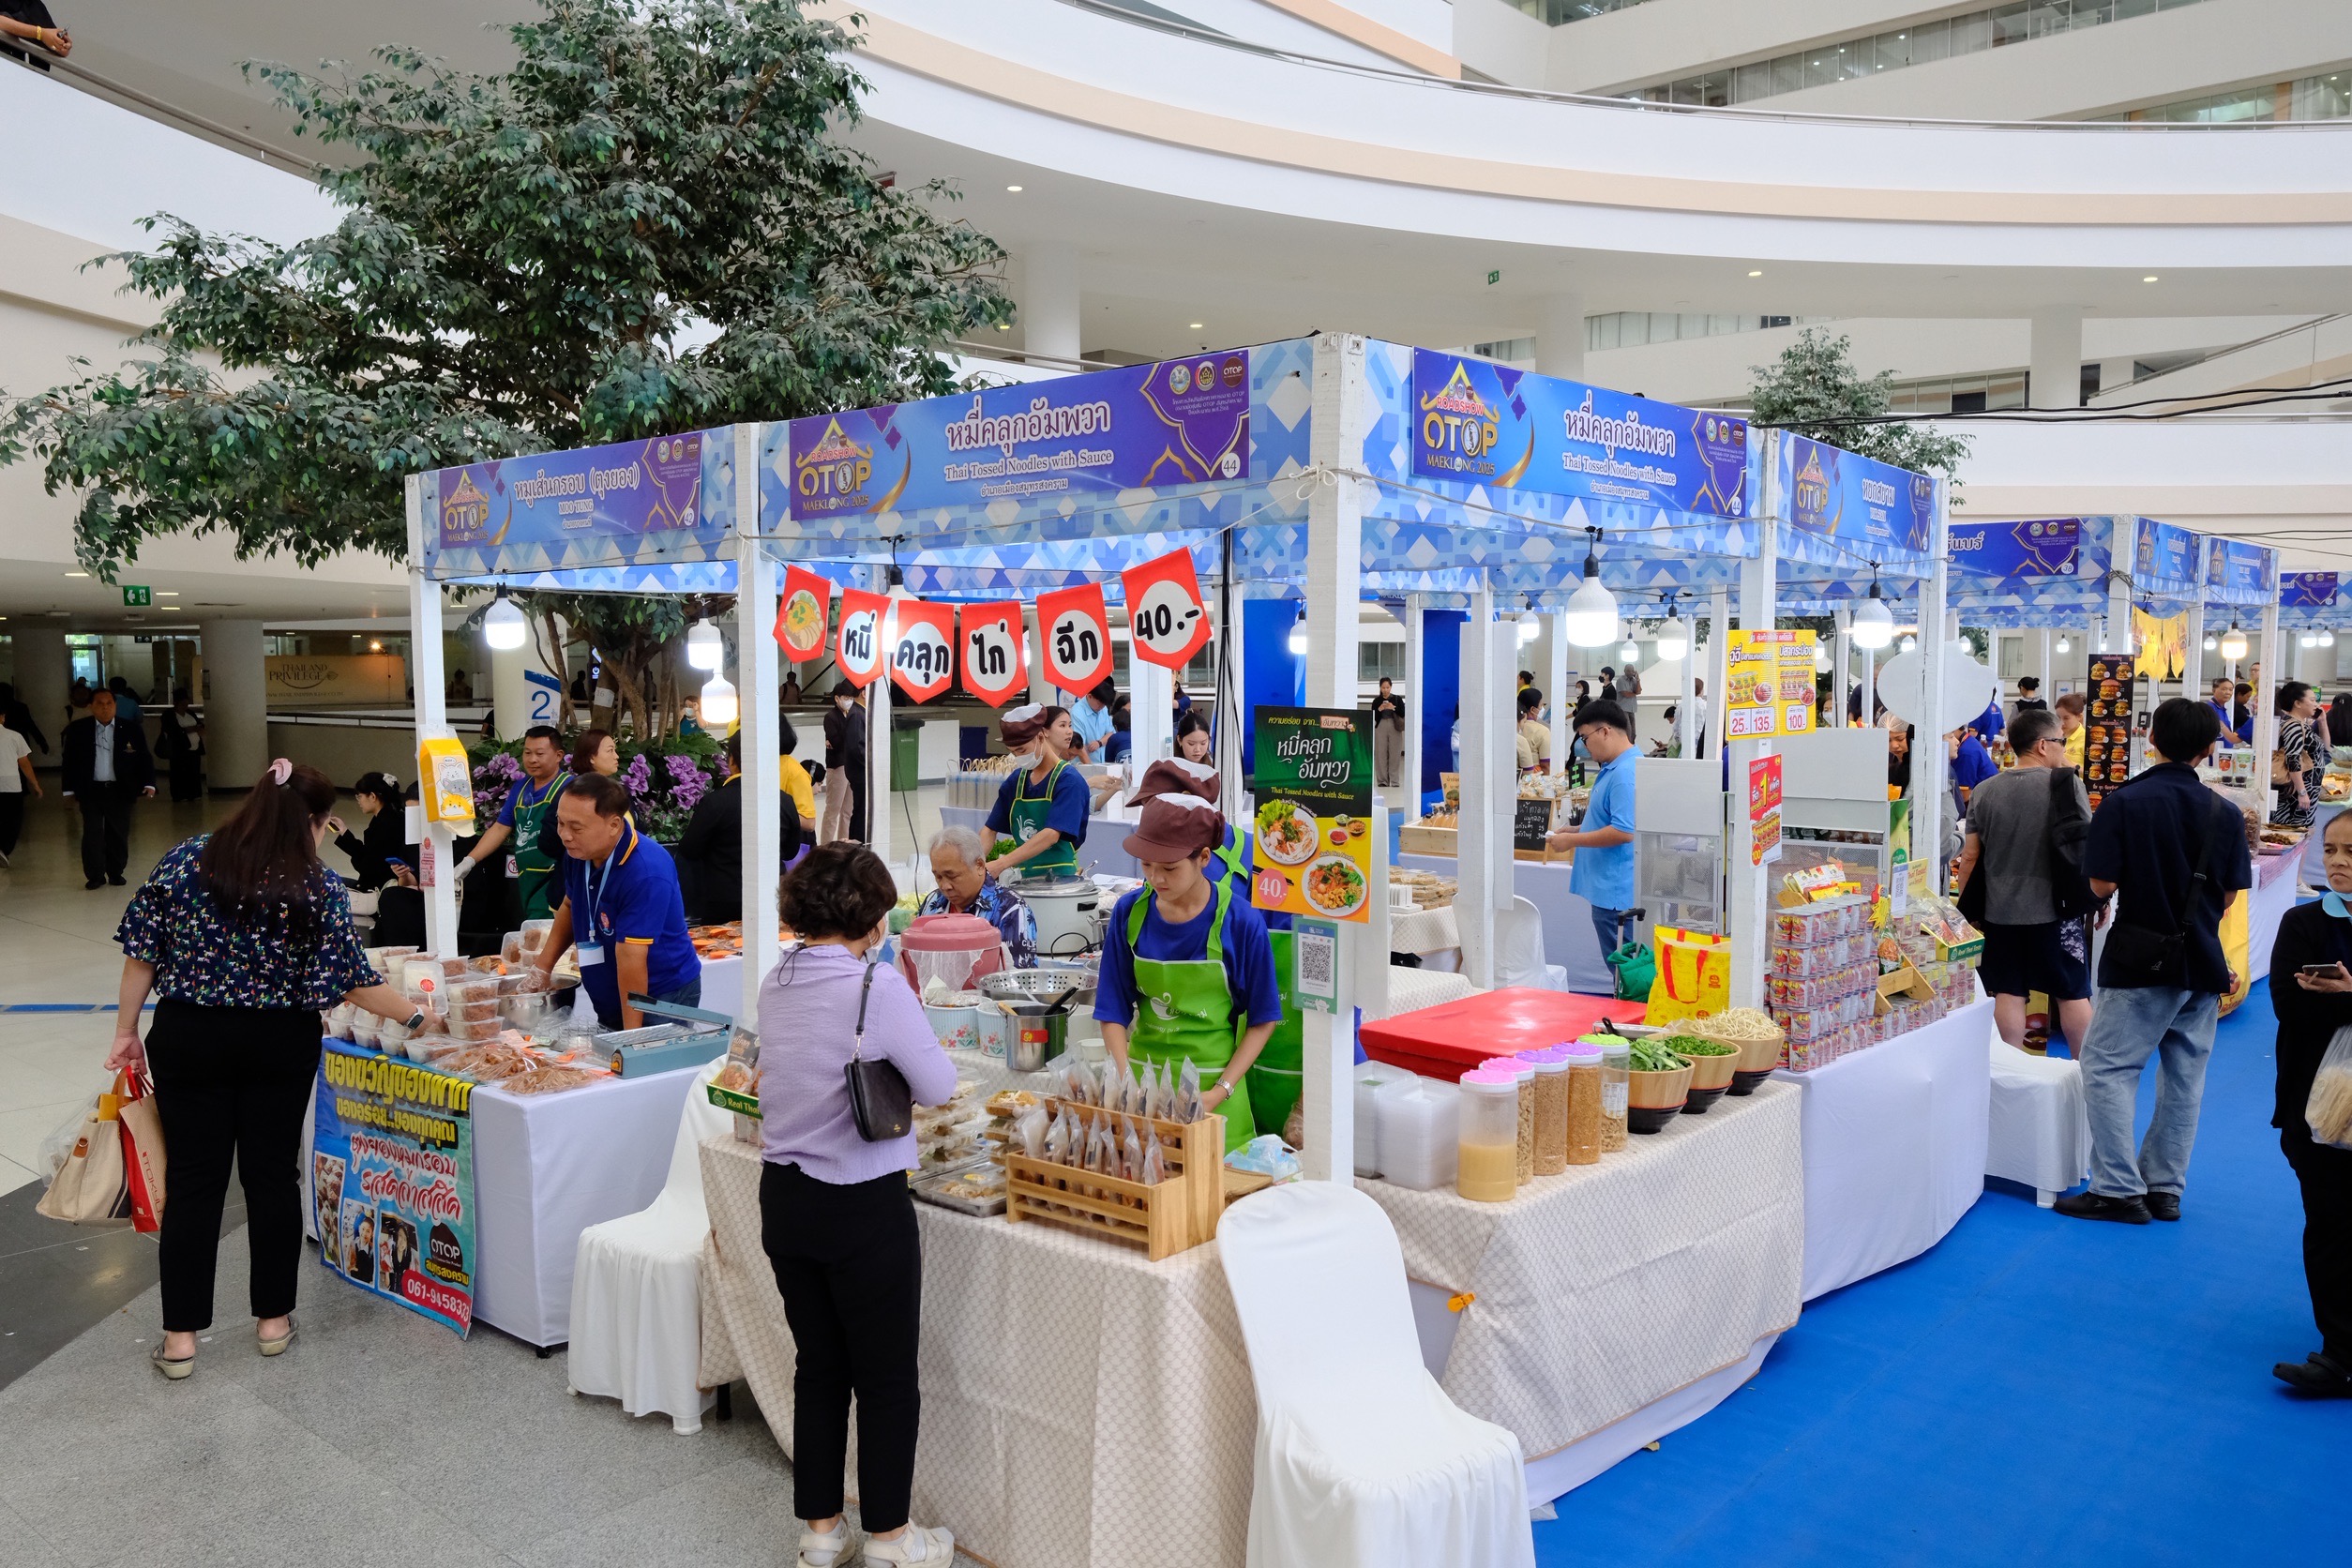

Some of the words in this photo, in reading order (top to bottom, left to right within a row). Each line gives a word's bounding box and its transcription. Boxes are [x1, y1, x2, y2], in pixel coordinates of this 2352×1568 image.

[1224, 366, 1243, 375] OTOP
[1437, 395, 1485, 416] ROADSHOW
[947, 396, 1109, 456] หมี่คลุกอัมพวา
[1424, 412, 1499, 458] OTOP
[1563, 389, 1676, 458] หมี่คลุกอัมพวา
[811, 446, 858, 462] ROADSHOW
[945, 466, 968, 480] Thai
[971, 459, 1004, 476] Tossed
[1007, 456, 1048, 473] Noodles
[1051, 453, 1076, 468] with
[1079, 449, 1113, 465] Sauce
[1223, 460, 1237, 472] 44
[1426, 453, 1475, 473] MAEKLONG
[1477, 461, 1496, 475] 2025
[1563, 453, 1582, 469] Thai
[1583, 457, 1608, 474] Tossed
[1609, 460, 1638, 479] Noodles
[1639, 466, 1655, 481] with
[1656, 468, 1677, 484] Sauce
[515, 468, 586, 509] หมูเส้นกรอบ
[589, 460, 640, 500] (ตุงยอง)
[799, 460, 871, 496] OTOP
[559, 500, 574, 515] MOO
[574, 498, 595, 513] TUNG
[803, 496, 850, 511] MAEKLONG
[852, 494, 869, 507] 2025
[1797, 481, 1829, 514] OTOP
[445, 504, 490, 530] OTOP
[684, 512, 693, 523] 42
[2062, 565, 2073, 573] 38
[846, 610, 877, 659] หมี่
[1136, 603, 1200, 641] 40.-
[972, 621, 1005, 675] ไก่
[1056, 621, 1097, 665] ฉีก
[269, 671, 324, 681] PRIVILEGE
[282, 663, 328, 672] THAILAND
[896, 640, 950, 685] คลุก
[531, 689, 550, 720] 2
[1268, 716, 1302, 726] ความอร่อย
[1277, 731, 1332, 761] หมี่คลุก
[1299, 756, 1350, 788] อัมพวา
[1271, 786, 1283, 794] Thai
[1303, 789, 1323, 797] Noodles
[1337, 792, 1355, 800] Sauce
[1760, 772, 1769, 807] 1
[1259, 877, 1288, 898] 40.-
[728, 1097, 743, 1109] Real
[745, 1102, 760, 1114] Thai
[351, 1134, 457, 1182] ตุงยองหมูกรอบ
[431, 1238, 460, 1259] OTOP
